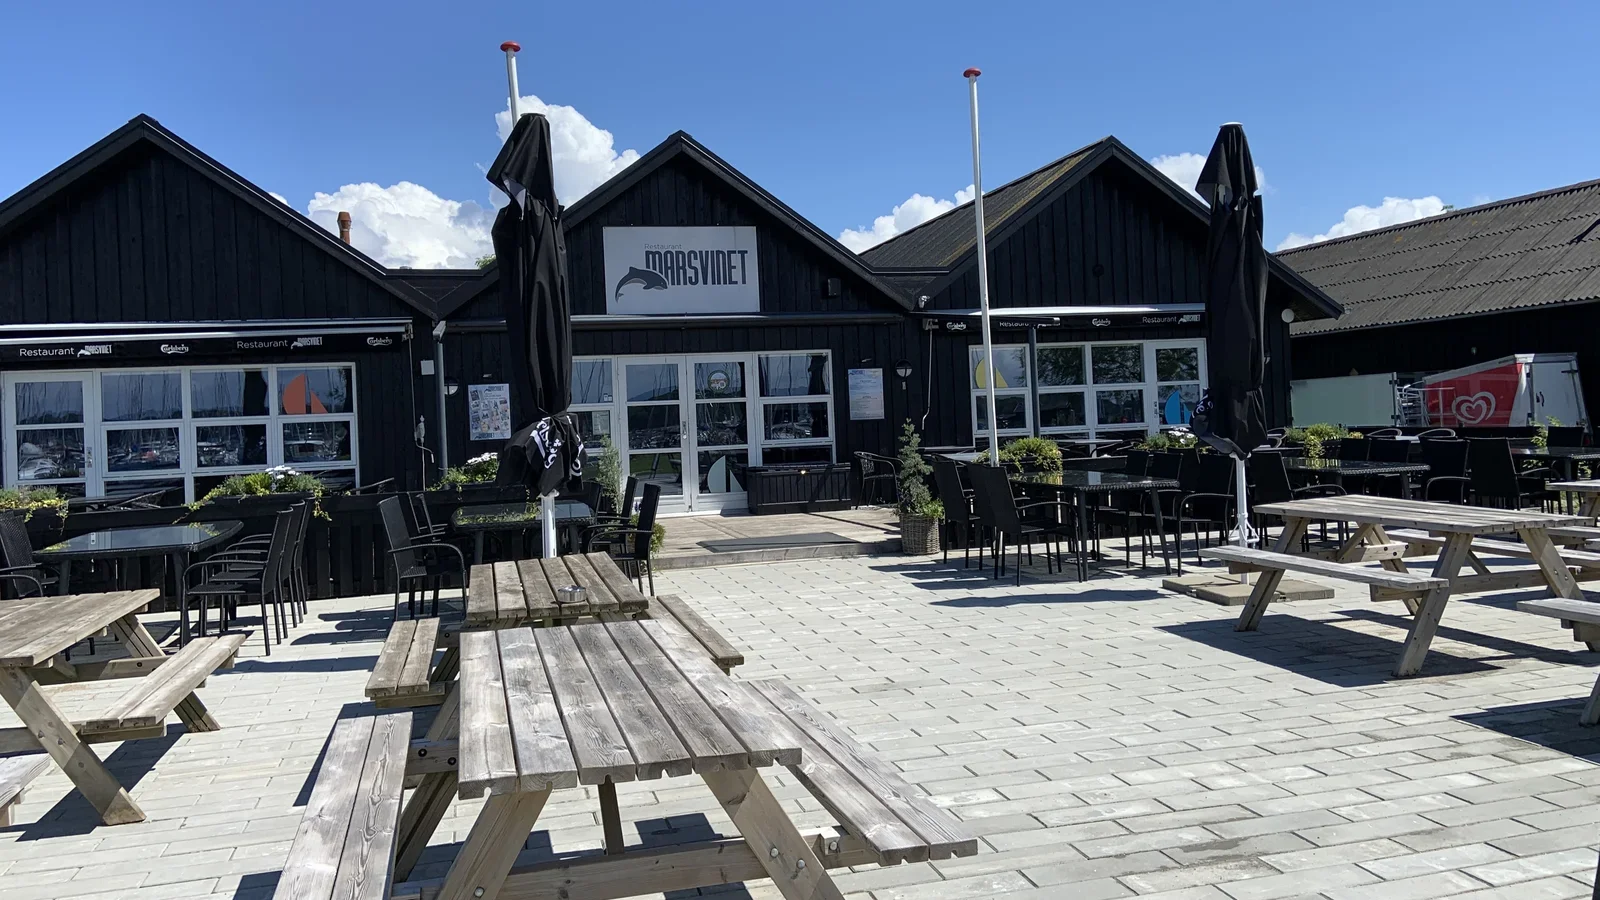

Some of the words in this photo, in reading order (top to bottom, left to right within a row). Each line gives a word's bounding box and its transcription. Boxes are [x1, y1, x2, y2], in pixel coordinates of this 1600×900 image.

[644, 250, 748, 286] MARSVINET
[1142, 315, 1177, 324] Restaurant
[236, 340, 288, 349] Restaurant
[366, 336, 393, 347] Carlsberg
[19, 347, 75, 357] Restaurant
[160, 344, 190, 355] Carlsberg
